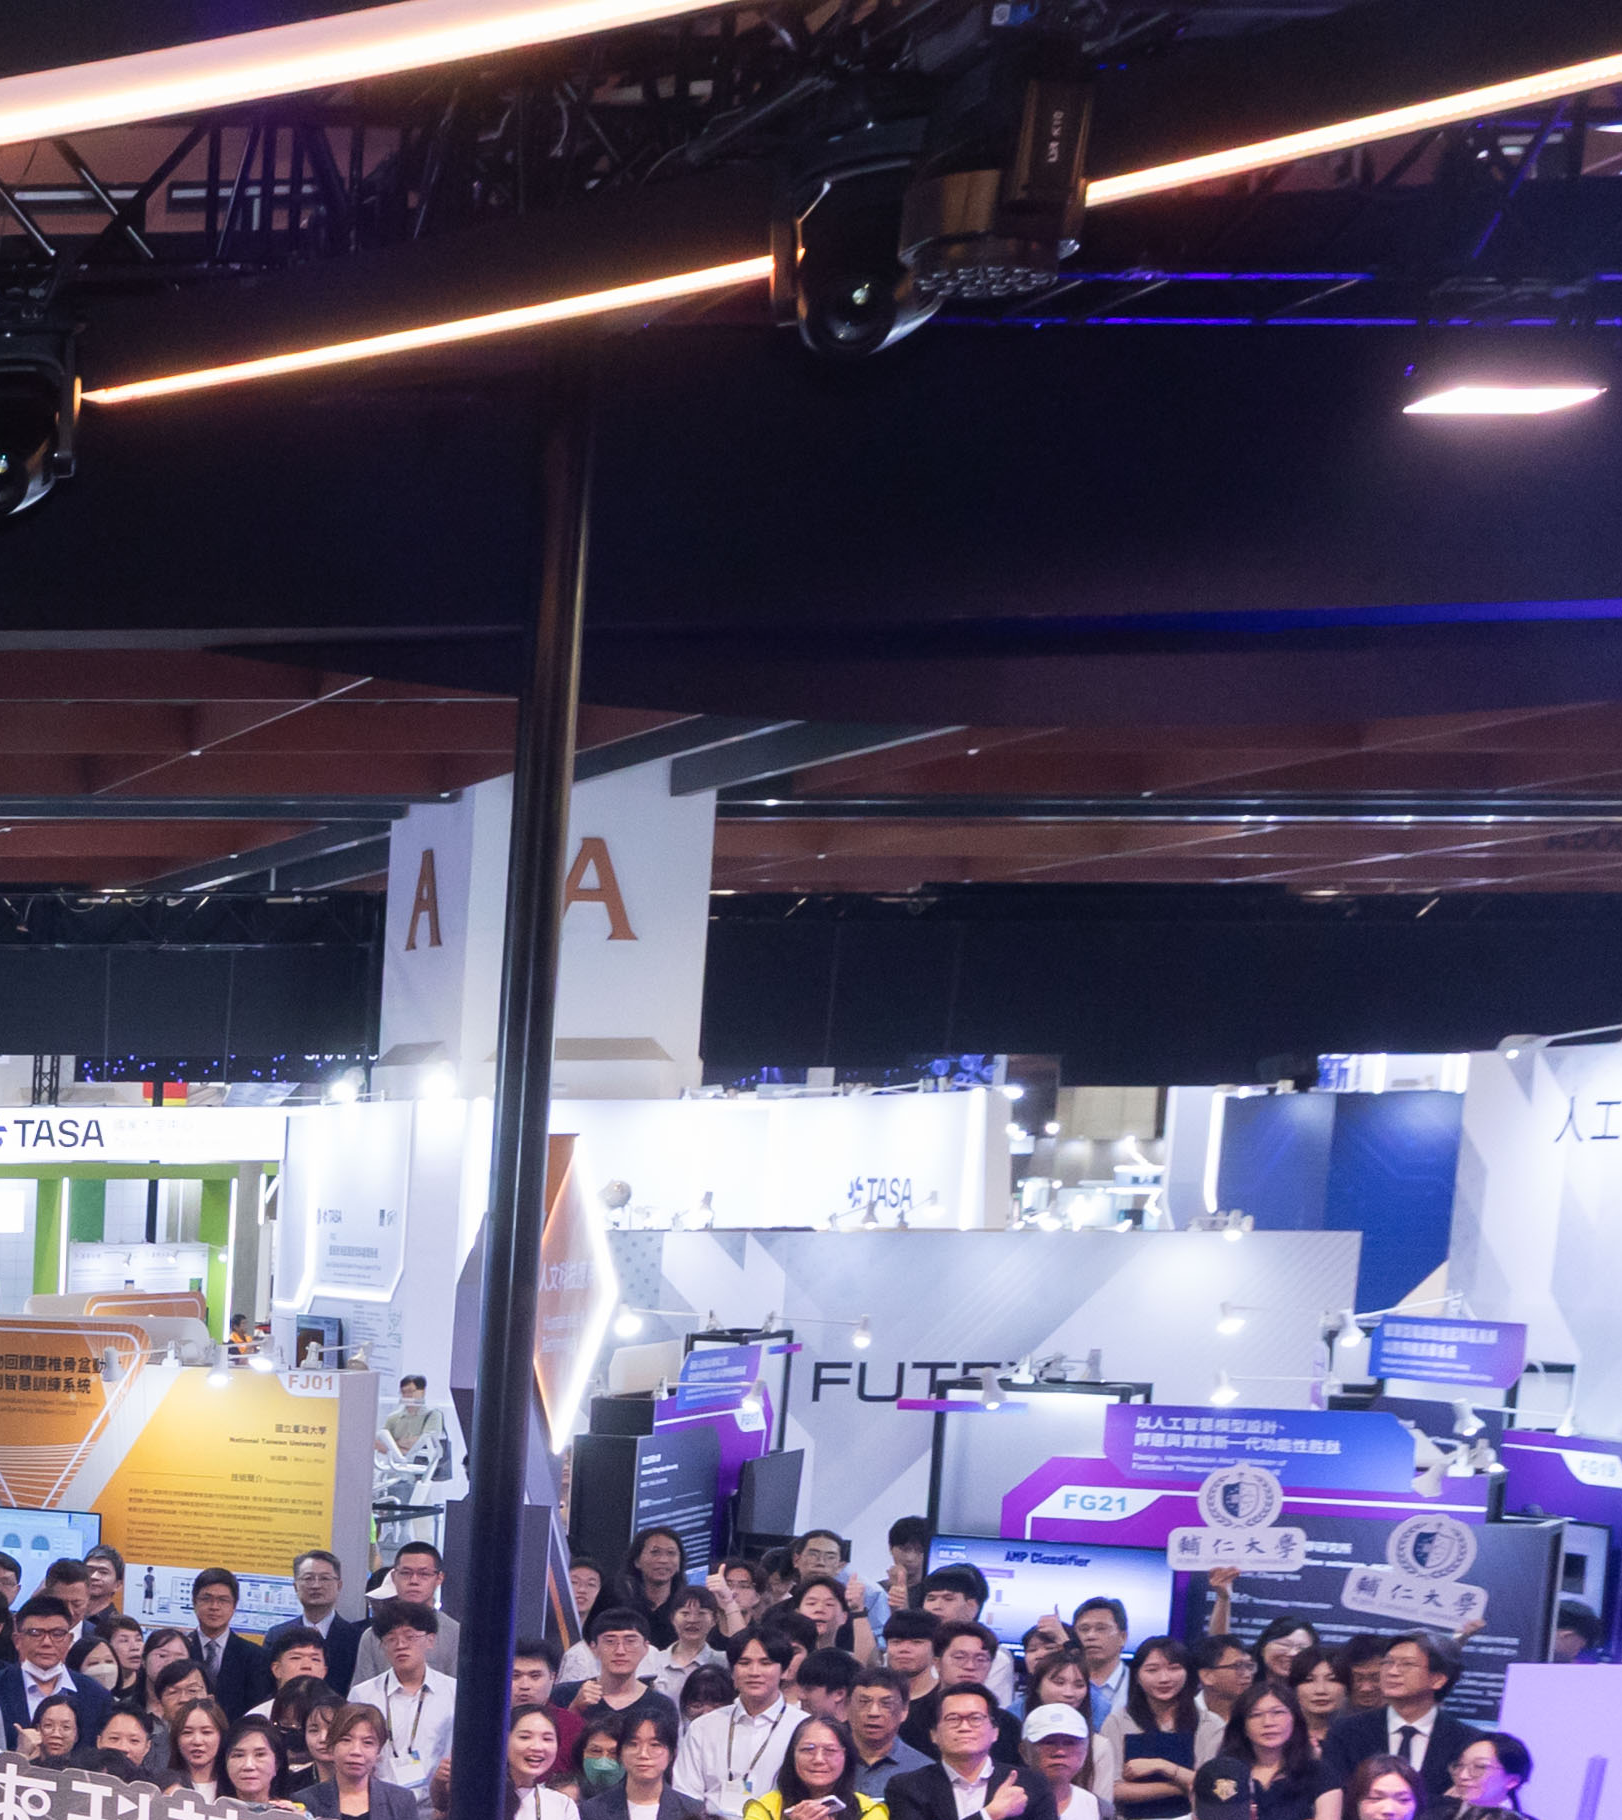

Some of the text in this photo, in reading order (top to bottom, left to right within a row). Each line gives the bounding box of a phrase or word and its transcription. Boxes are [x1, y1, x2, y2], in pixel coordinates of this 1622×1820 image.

[562, 837, 638, 941] A
[13, 1119, 105, 1148] TASA
[867, 1178, 913, 1209] TASA
[287, 1374, 334, 1391] FJ01
[1063, 1493, 1128, 1513] FG21
[1004, 1549, 1091, 1568] AMP Classifier
[1177, 1532, 1300, 1560] 輔仁大學
[1355, 1575, 1479, 1618] 輔仁大學
